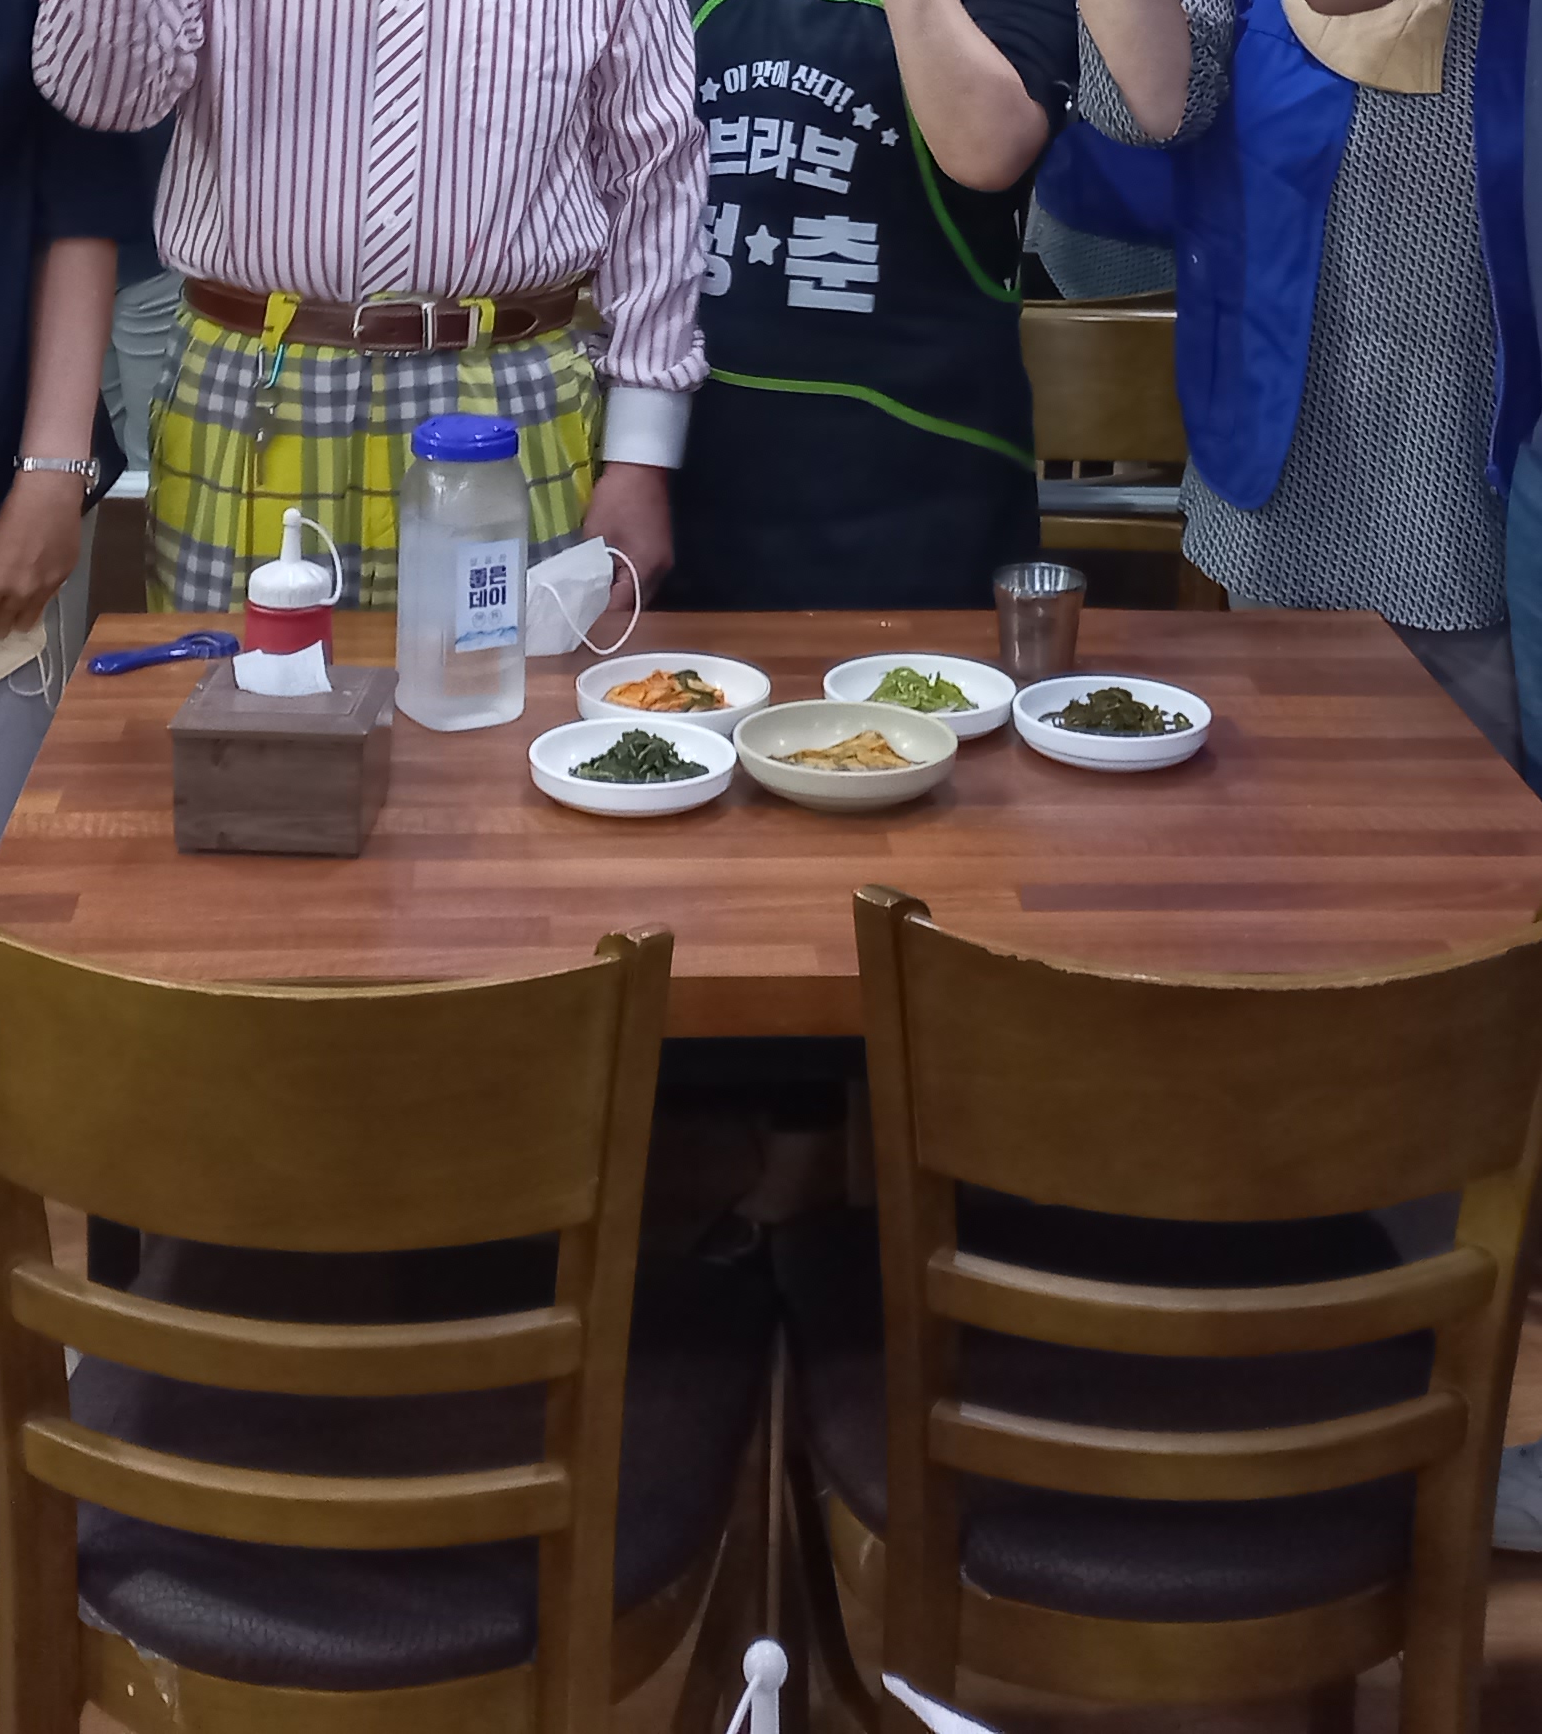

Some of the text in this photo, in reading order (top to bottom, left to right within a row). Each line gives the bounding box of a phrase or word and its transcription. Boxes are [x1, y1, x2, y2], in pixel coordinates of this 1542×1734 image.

[723, 60, 855, 113] 이 맛에 산다!
[708, 116, 859, 194] 브라보
